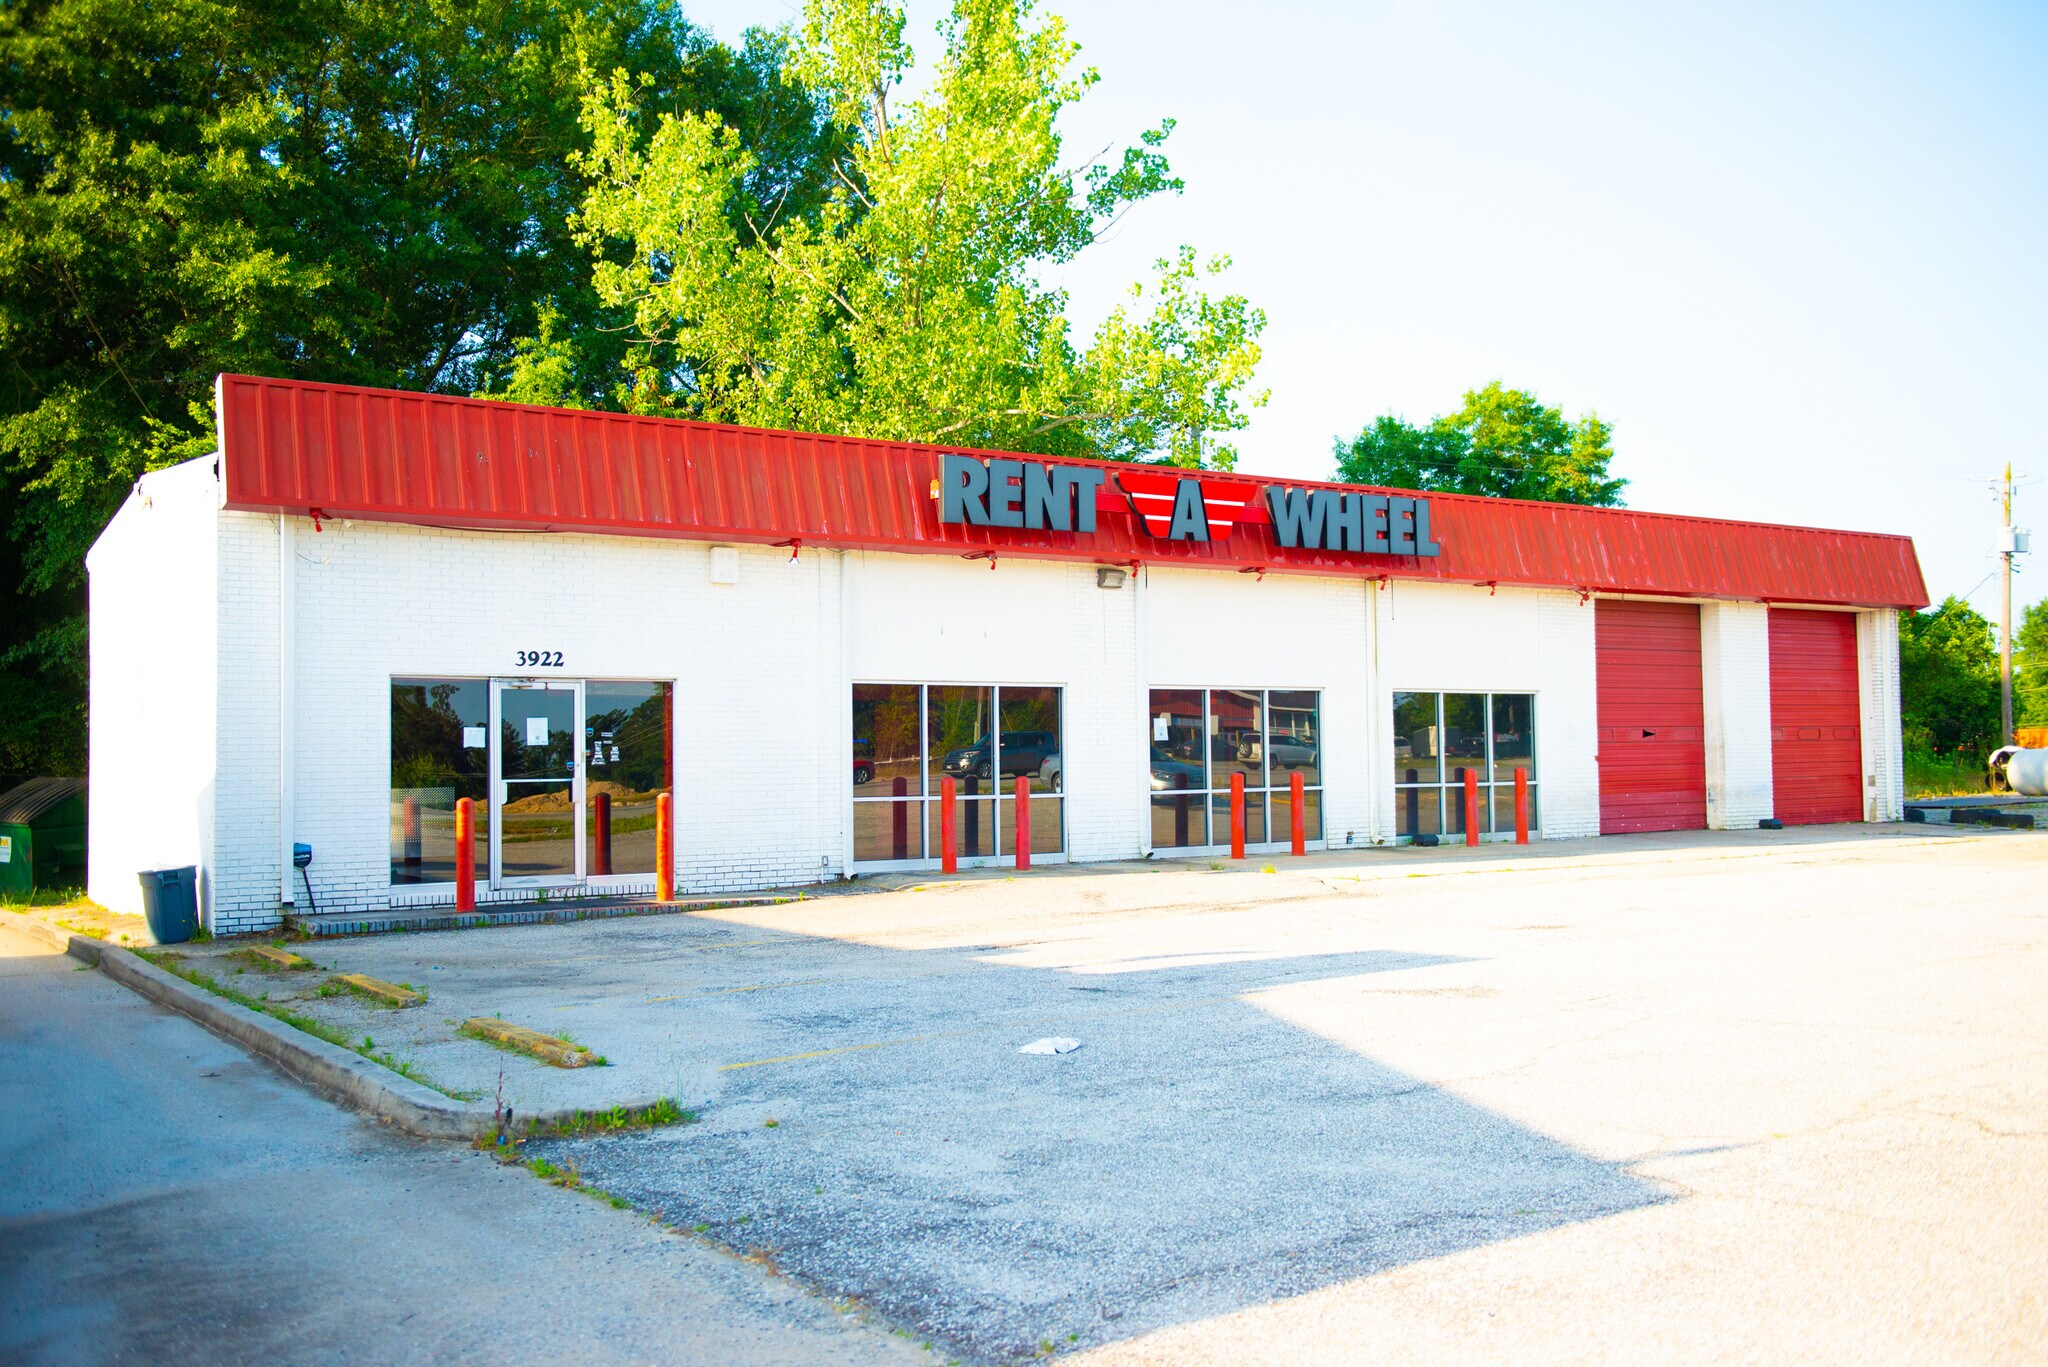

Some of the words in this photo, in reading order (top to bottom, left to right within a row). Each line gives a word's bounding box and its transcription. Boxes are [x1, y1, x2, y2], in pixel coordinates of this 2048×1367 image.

[939, 454, 1105, 532] RENT
[1168, 479, 1211, 541] A
[1263, 485, 1440, 556] WHEEL
[515, 650, 565, 667] 3922
